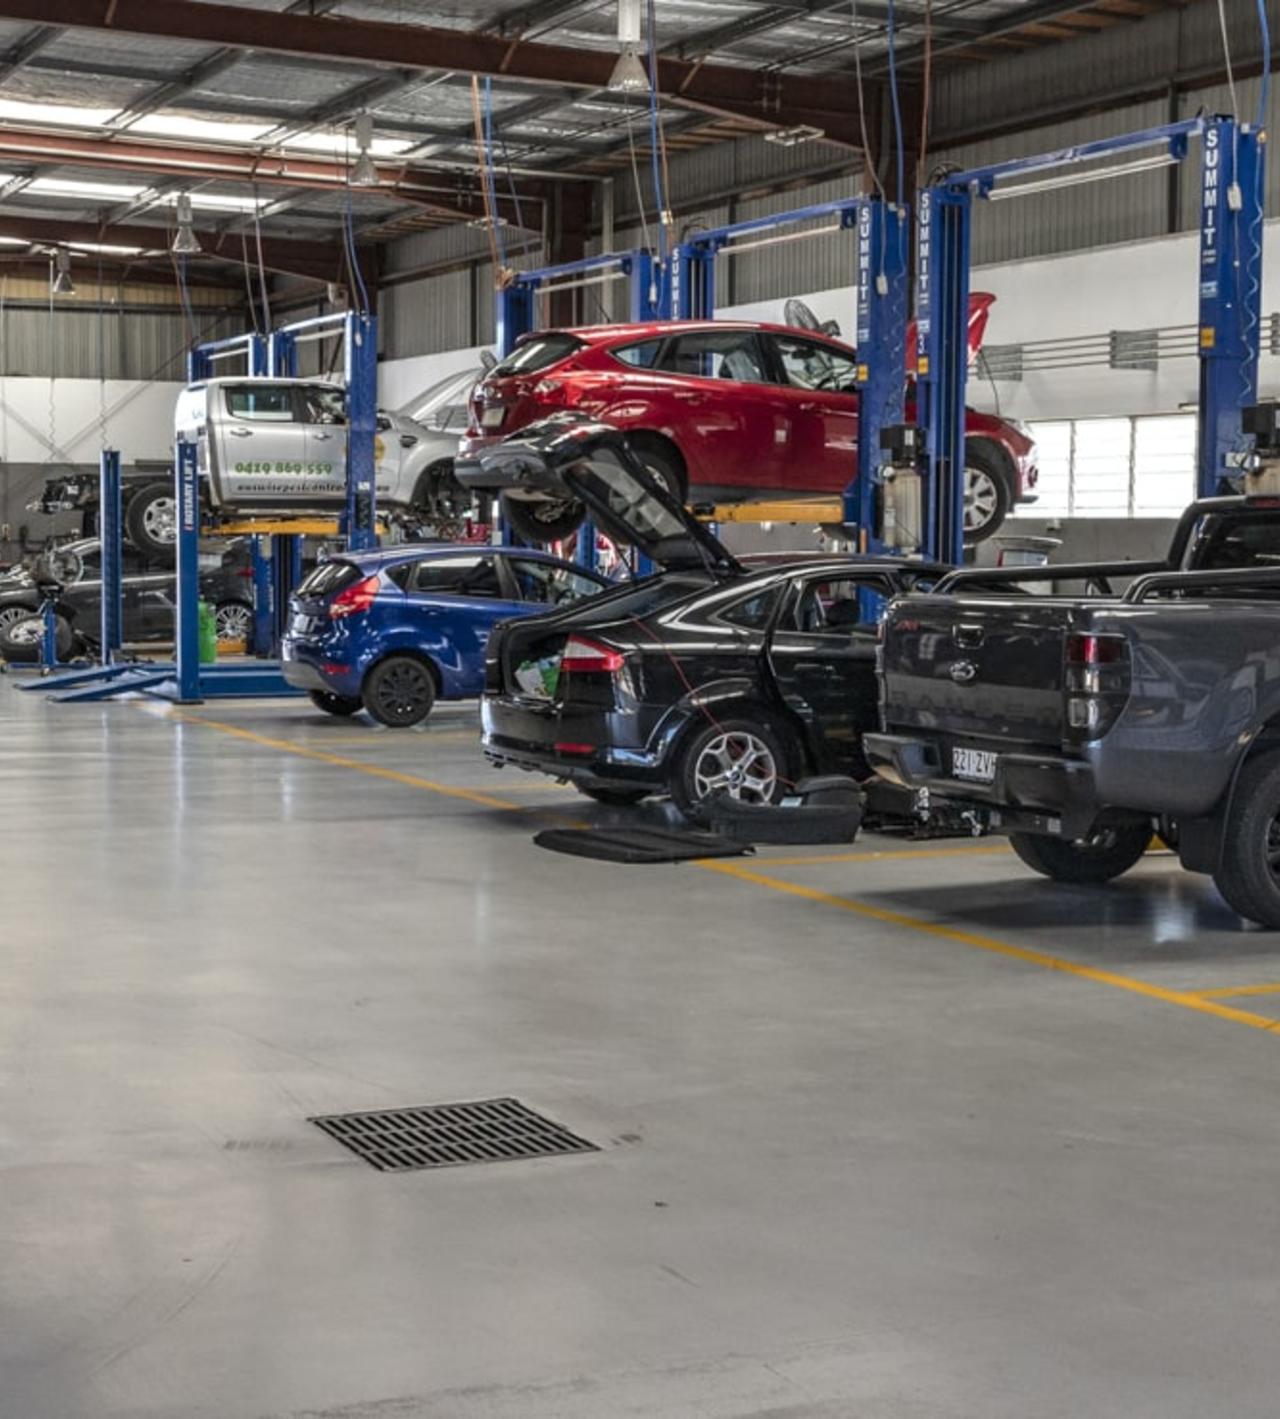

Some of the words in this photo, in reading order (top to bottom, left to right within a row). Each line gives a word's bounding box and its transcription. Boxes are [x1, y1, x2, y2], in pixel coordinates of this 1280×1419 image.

[1204, 129, 1218, 245] SUMMIT
[859, 207, 870, 300] SUMMIT
[920, 193, 930, 290] SUMMIT
[918, 335, 925, 354] 3
[184, 459, 193, 481] LIFT
[235, 462, 270, 474] 0419
[275, 462, 302, 474] 869
[308, 462, 332, 475] 559
[184, 483, 194, 525] ROTARY
